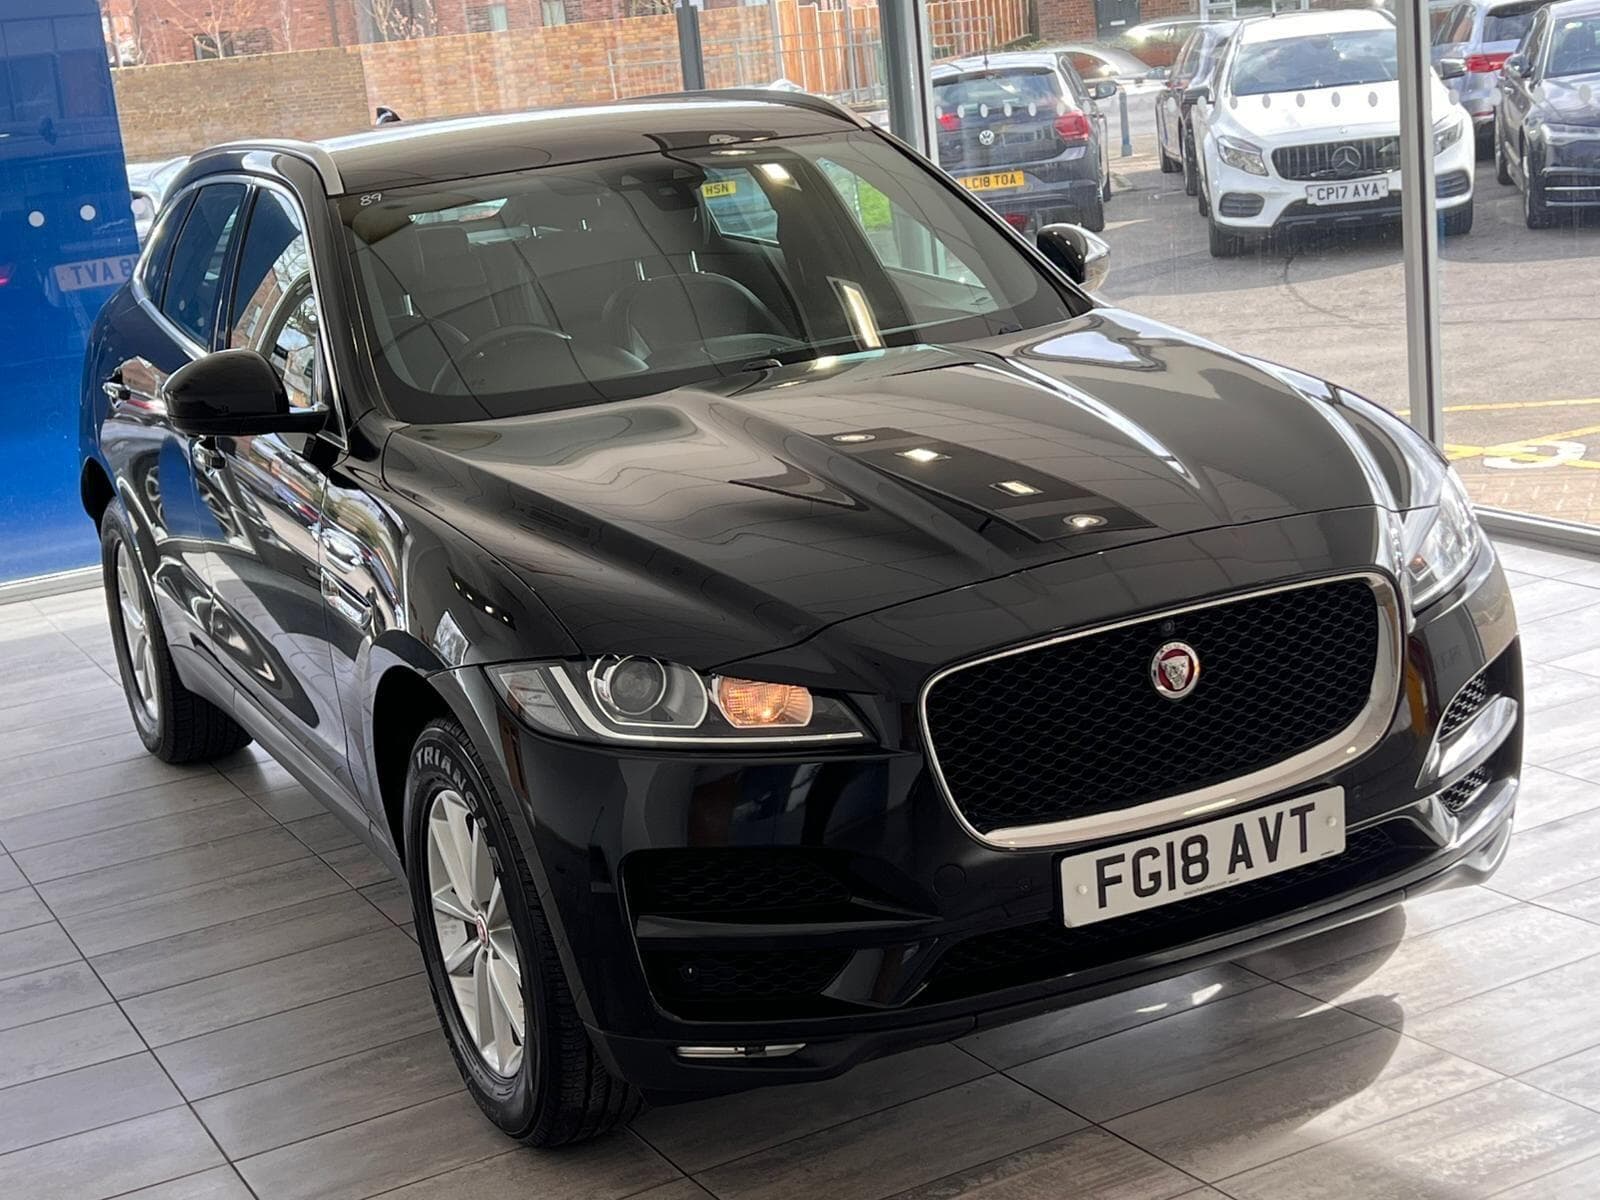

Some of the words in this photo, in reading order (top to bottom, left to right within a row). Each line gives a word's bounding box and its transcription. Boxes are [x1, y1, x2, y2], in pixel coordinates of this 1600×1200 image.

[705, 183, 729, 195] HSN
[964, 176, 991, 189] LC18
[1317, 185, 1348, 201] CP17
[1352, 182, 1380, 198] AYA
[360, 192, 382, 206] 89
[1095, 834, 1210, 910] FG18
[1227, 801, 1316, 875] AVT
